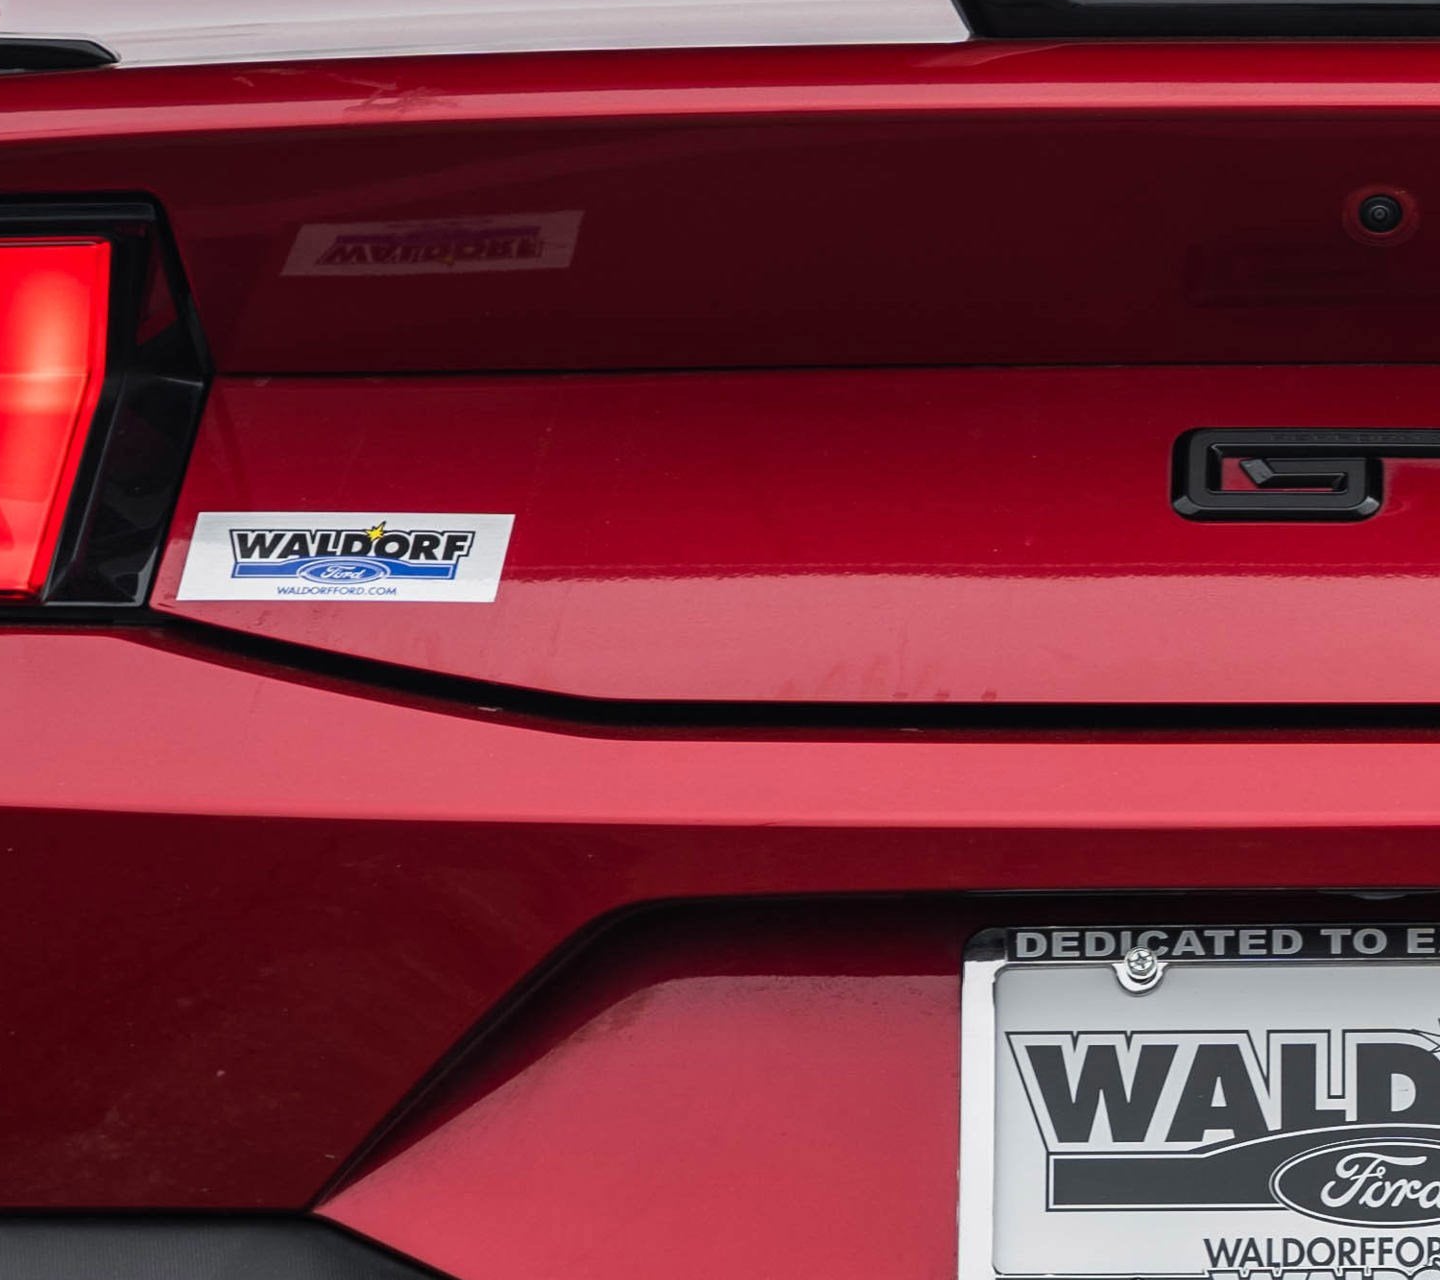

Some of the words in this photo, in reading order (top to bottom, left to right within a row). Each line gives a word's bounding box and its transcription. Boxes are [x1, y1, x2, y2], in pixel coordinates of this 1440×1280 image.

[232, 530, 474, 561] WALDORF
[320, 565, 364, 580] Ford
[277, 586, 397, 596] WALDORFFORD.COM
[1016, 929, 1303, 958] DEDICATED
[1319, 927, 1389, 954] TO
